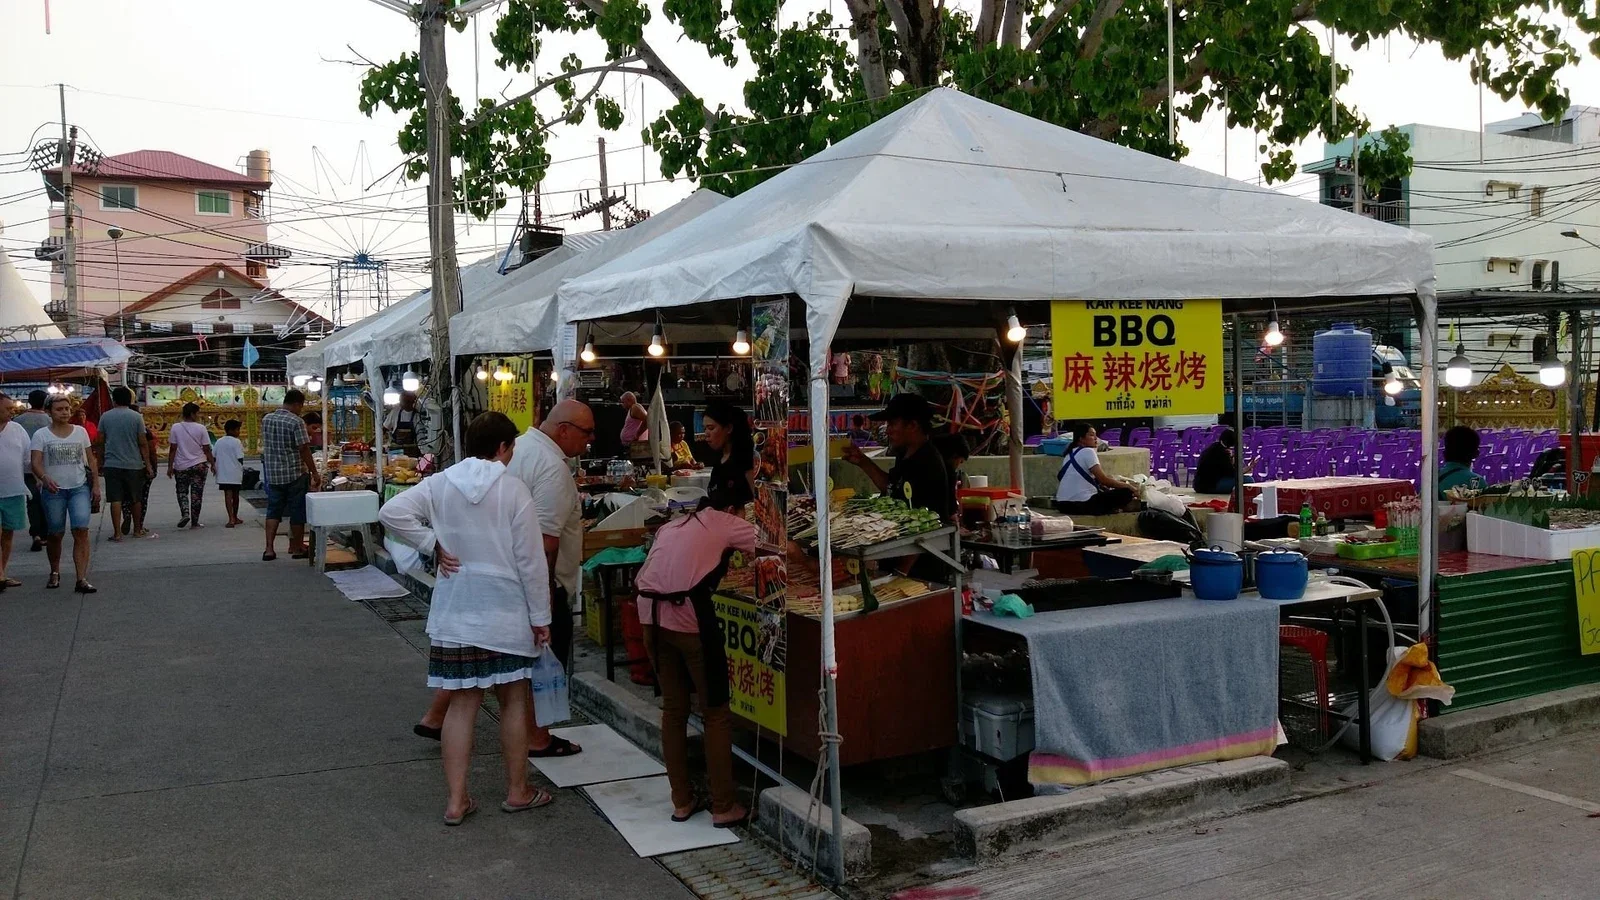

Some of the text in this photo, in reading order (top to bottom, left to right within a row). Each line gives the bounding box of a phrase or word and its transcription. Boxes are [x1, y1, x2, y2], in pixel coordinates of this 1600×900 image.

[1086, 300, 1184, 310] KAR KEE NANG
[1093, 314, 1176, 347] BBQ
[1062, 350, 1207, 394] 麻辣烧烤
[727, 604, 740, 617] KEE
